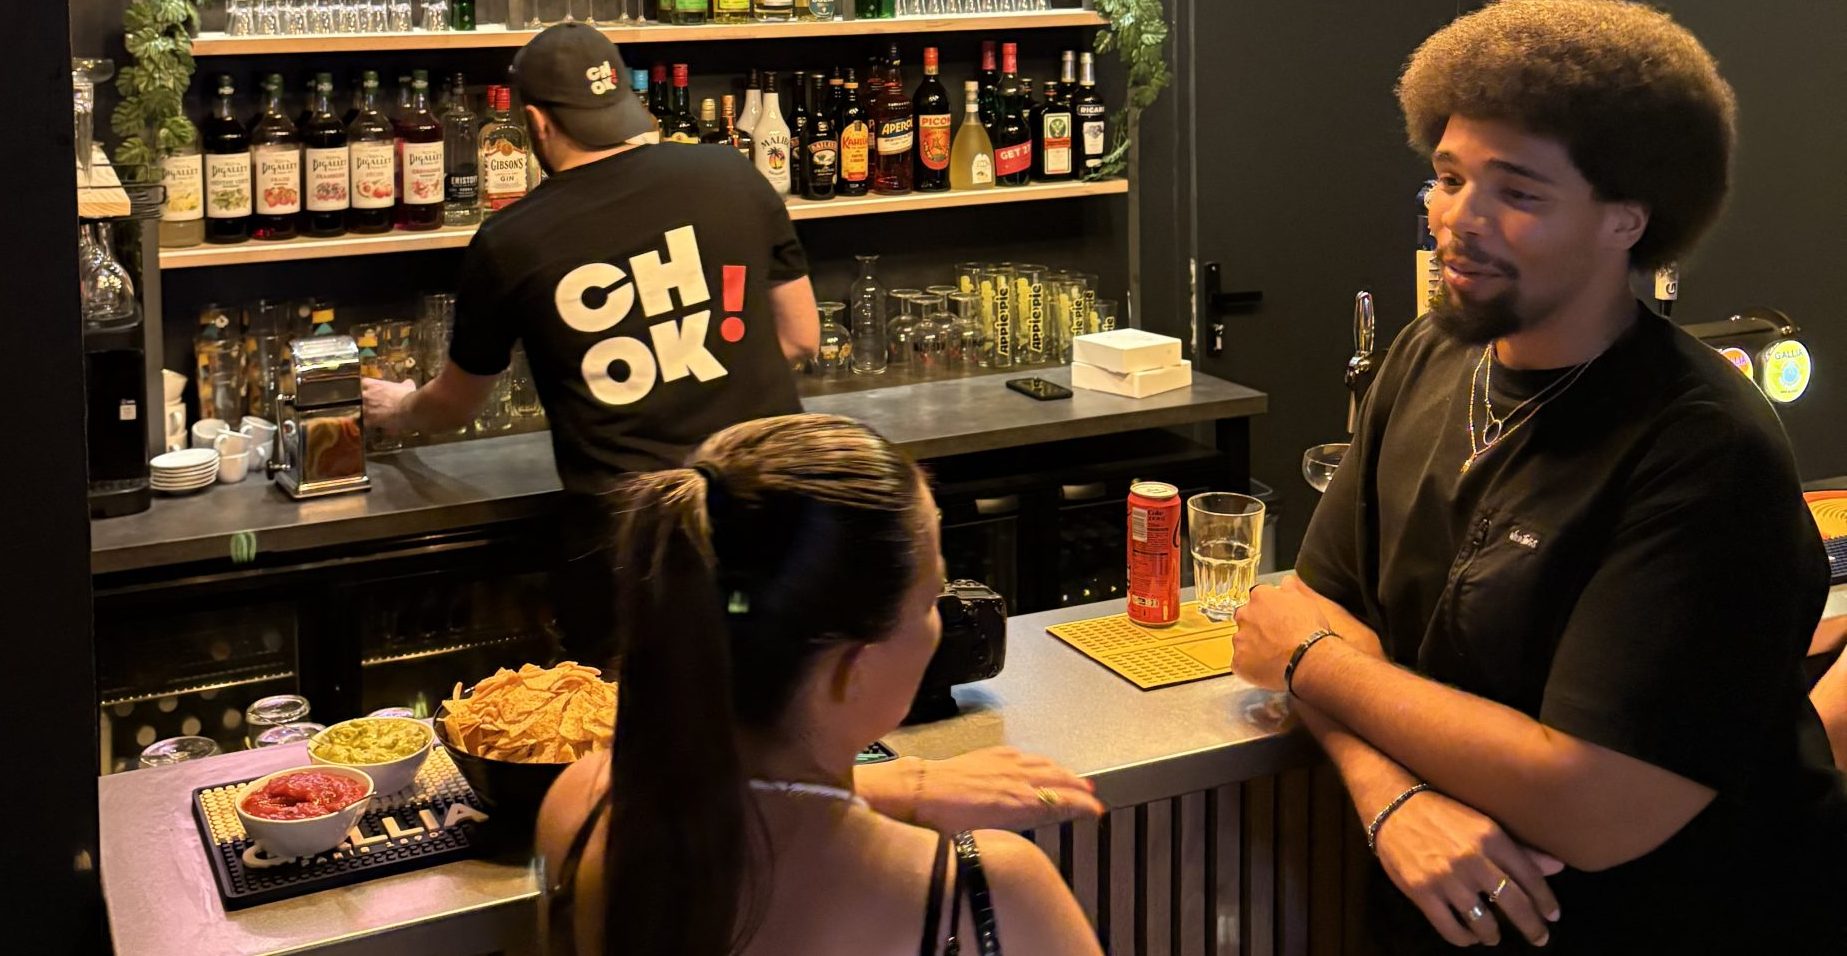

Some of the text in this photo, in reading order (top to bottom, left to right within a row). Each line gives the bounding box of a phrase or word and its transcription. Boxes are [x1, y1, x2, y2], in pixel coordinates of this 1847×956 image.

[1000, 149, 1020, 160] GET
[490, 158, 523, 171] GIBSON'S
[1775, 349, 1805, 360] GALLIA
